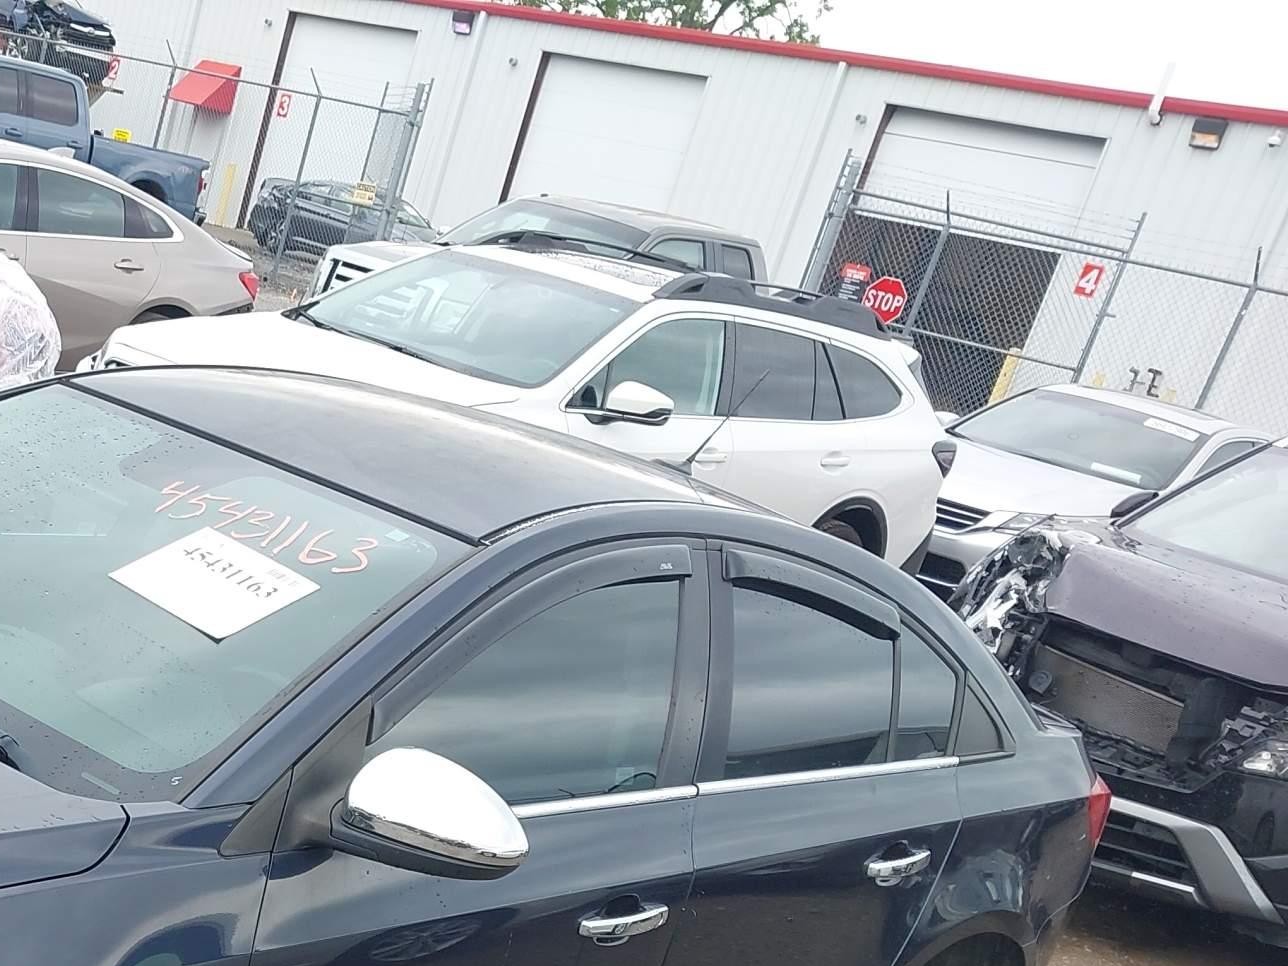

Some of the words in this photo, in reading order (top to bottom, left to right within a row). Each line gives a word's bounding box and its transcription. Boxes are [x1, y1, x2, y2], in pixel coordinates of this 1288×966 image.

[108, 59, 119, 79] 2
[278, 94, 290, 116] 3
[1078, 267, 1101, 295] 4
[864, 288, 904, 314] STOP
[154, 480, 379, 574] 45431163
[182, 545, 280, 600] 45431163
